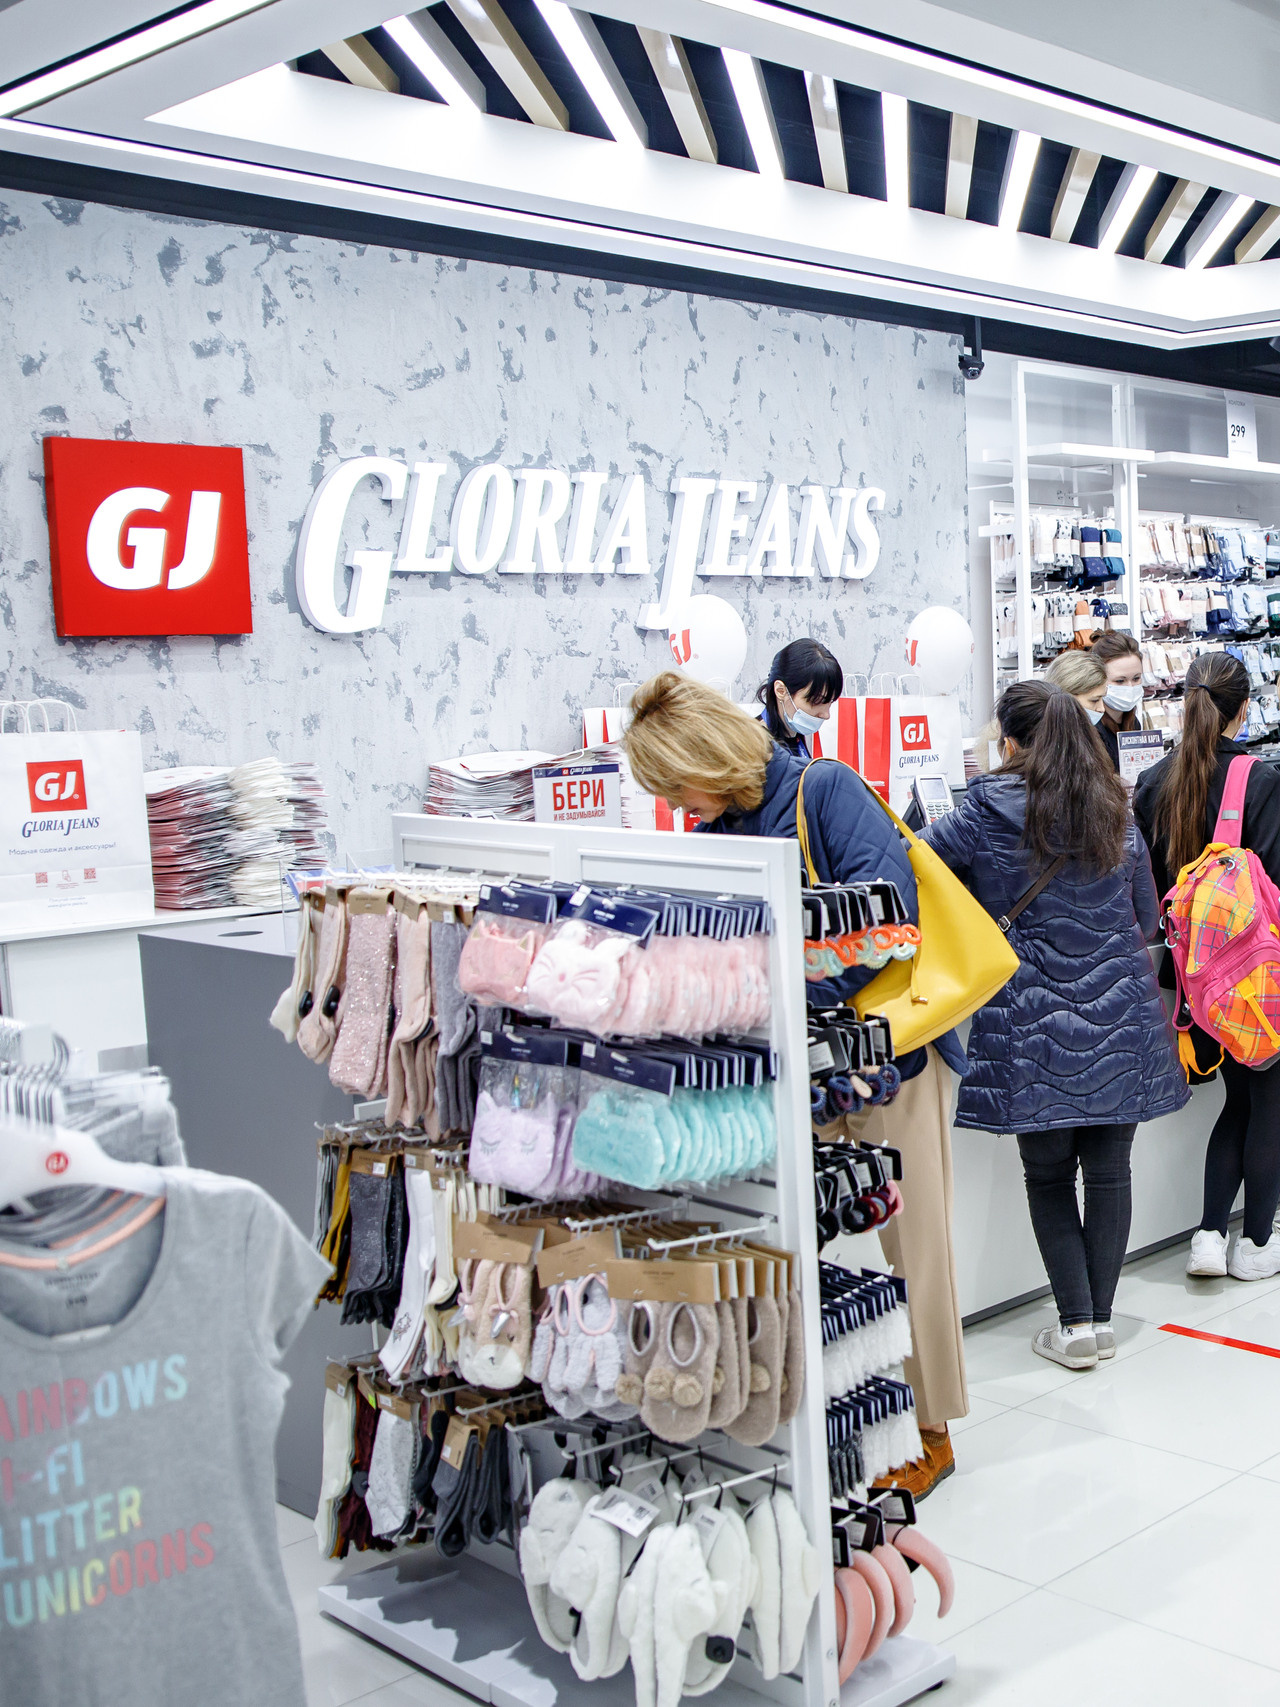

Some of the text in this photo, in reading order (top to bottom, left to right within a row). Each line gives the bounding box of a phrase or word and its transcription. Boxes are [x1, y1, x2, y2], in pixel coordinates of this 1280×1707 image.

[1231, 424, 1246, 437] 299
[86, 487, 222, 590] GJ
[296, 455, 885, 632] GLORIA JEANS
[669, 629, 692, 666] GJ
[903, 722, 925, 744] GJ
[1148, 734, 1161, 743] КАРТА
[899, 754, 940, 768] GLORIA JEANS
[34, 771, 78, 801] GJ
[552, 779, 605, 811] БЕРИ
[558, 812, 565, 821] НЕ
[566, 809, 606, 820] ЗАДУМЫВАЙСЯ!
[22, 817, 100, 837] GLORIA JEANS
[9, 848, 38, 856] Модная
[39, 846, 67, 854] одежда
[74, 842, 116, 851] аксессуары!
[4, 1522, 214, 1627] UNICORNS
